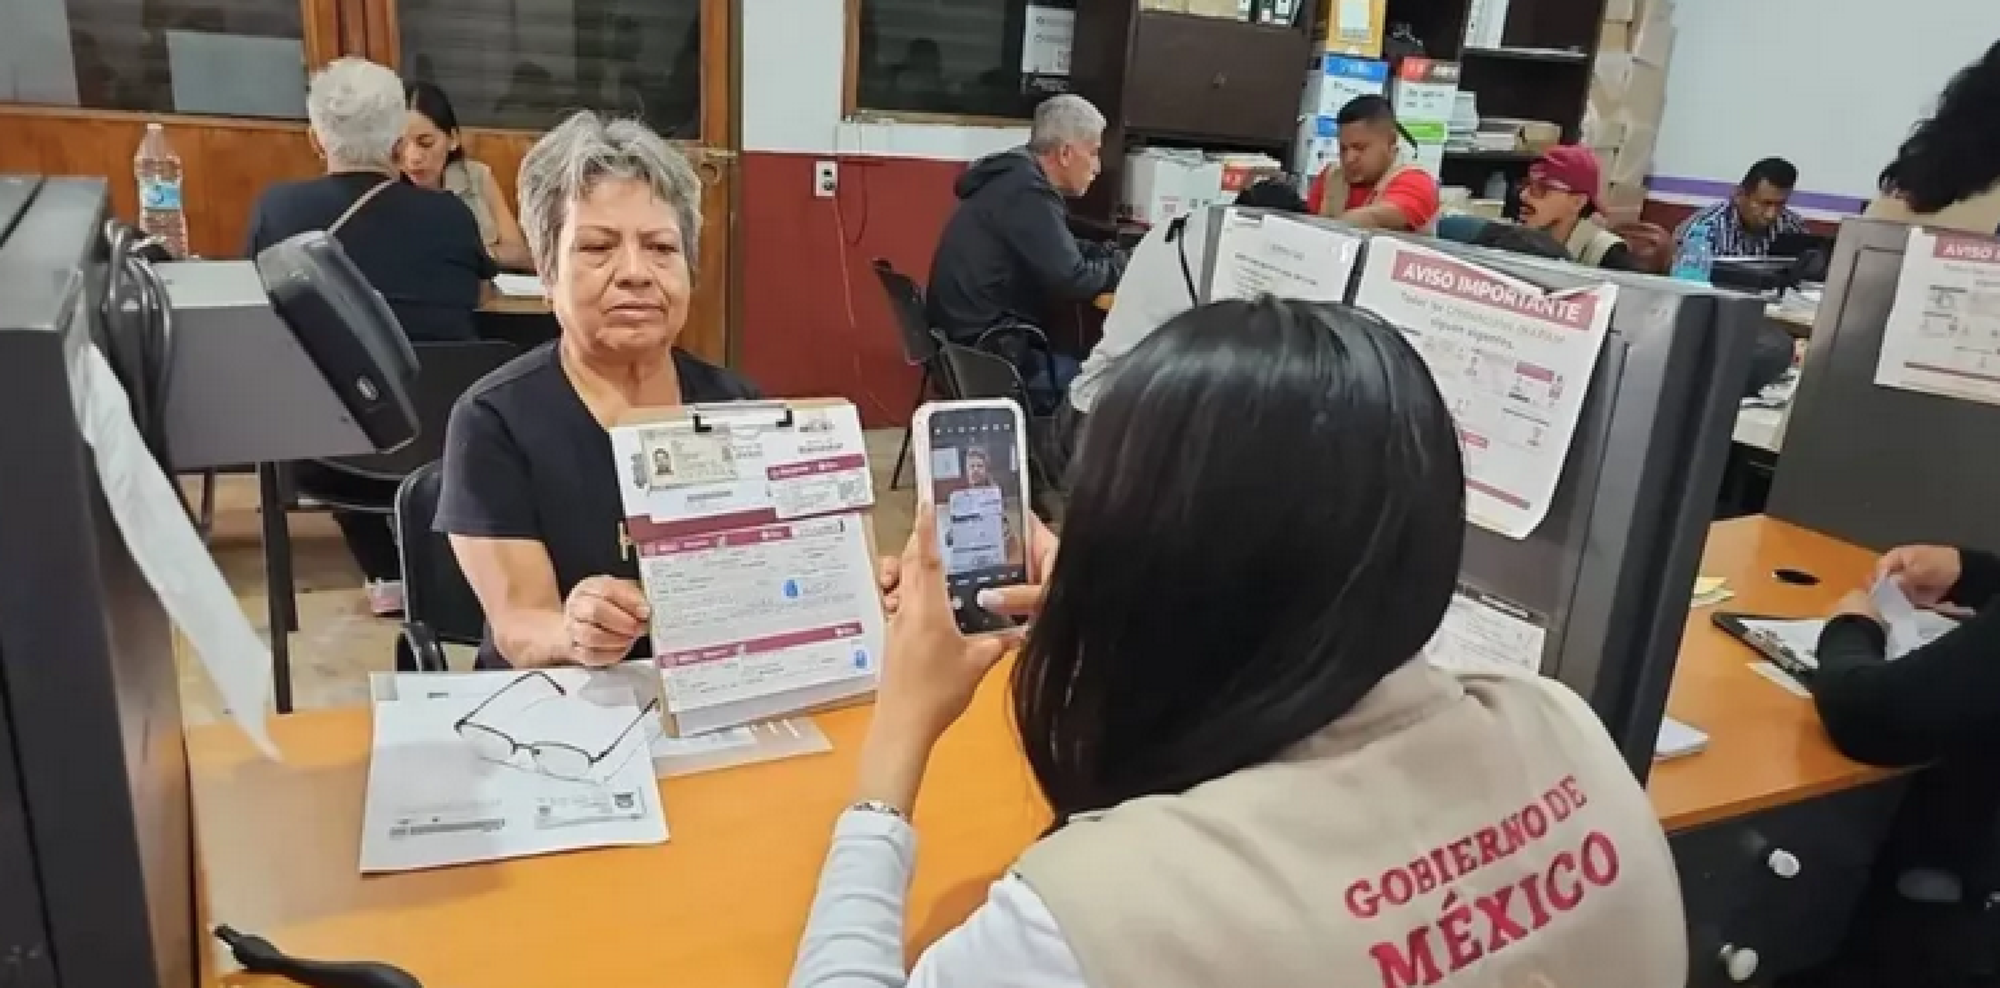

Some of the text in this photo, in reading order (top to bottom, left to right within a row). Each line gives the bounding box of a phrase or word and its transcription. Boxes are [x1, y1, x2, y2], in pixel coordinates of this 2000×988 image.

[1403, 262, 1454, 288] AVISO
[1456, 275, 1583, 322] IMPORTANTE
[1344, 775, 1588, 919] GOBIERNO DE
[1368, 831, 1620, 988] MÉXICO
